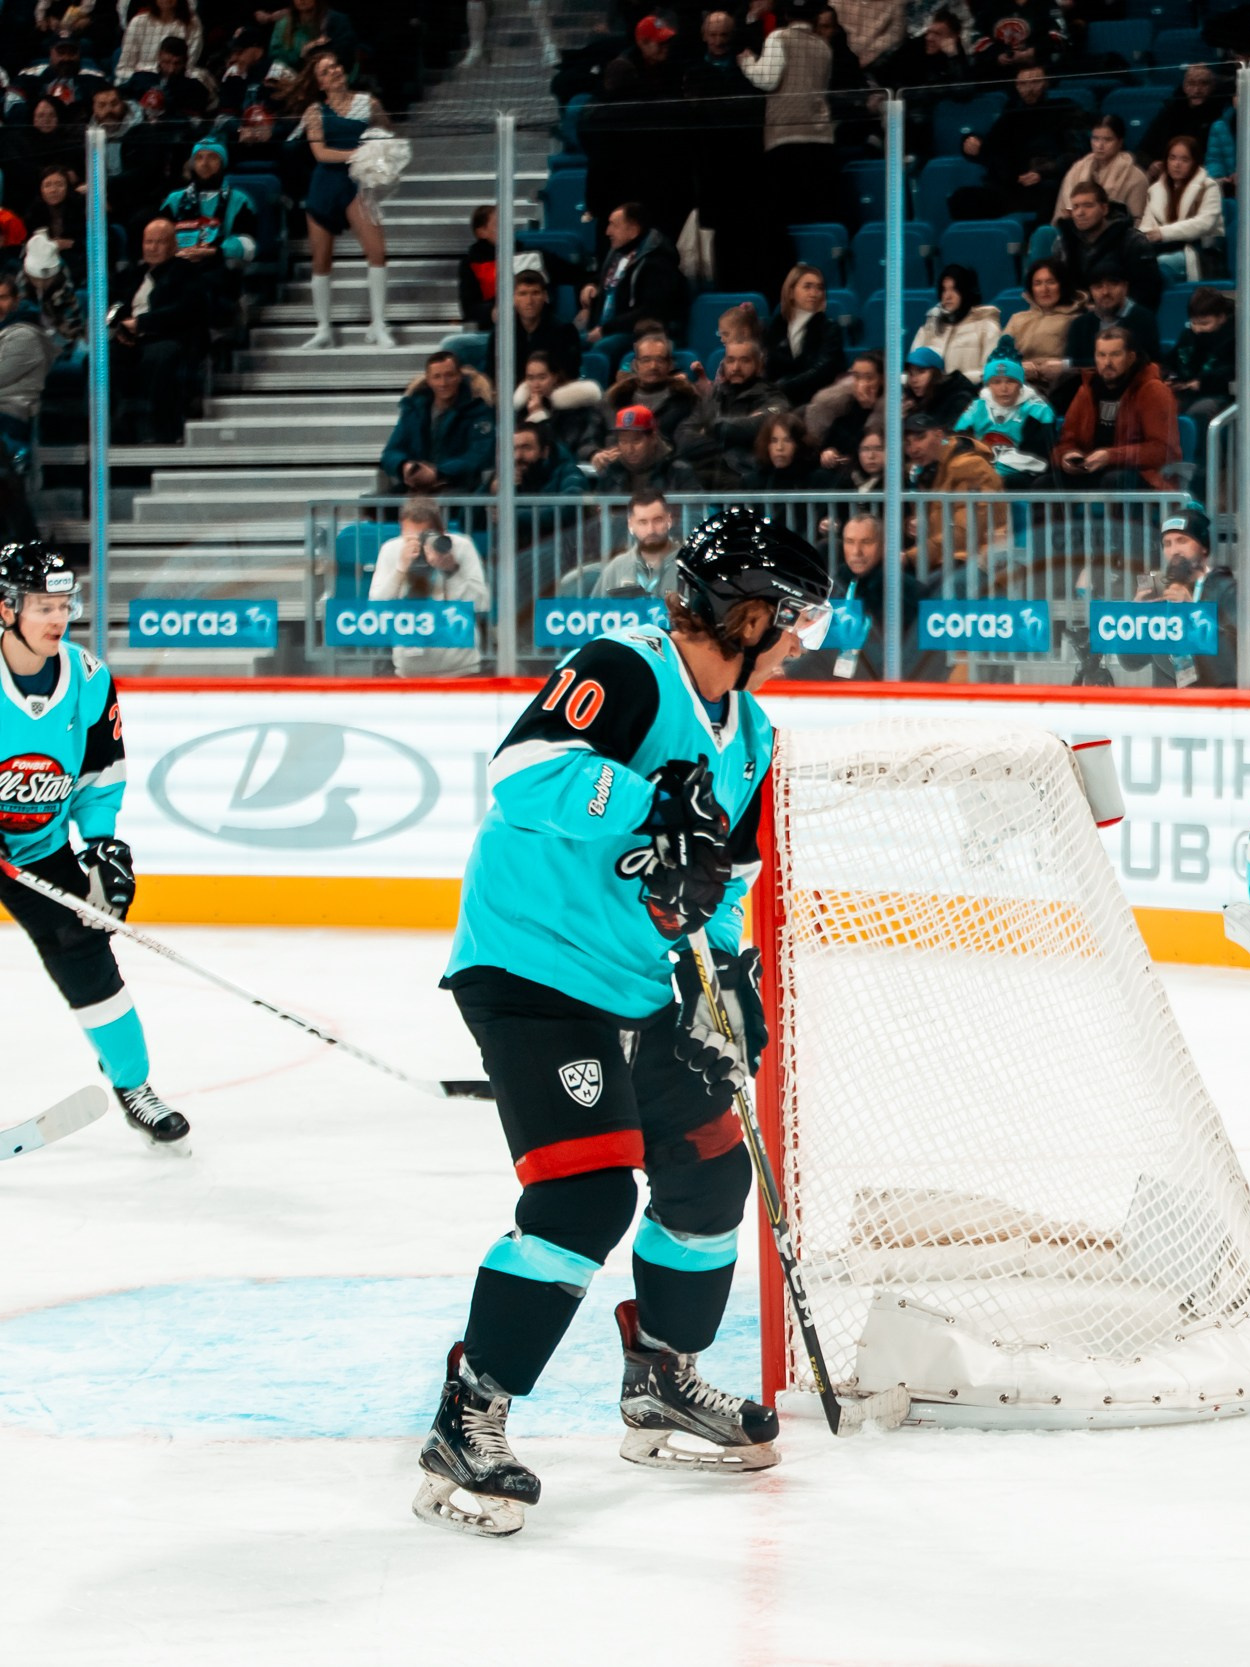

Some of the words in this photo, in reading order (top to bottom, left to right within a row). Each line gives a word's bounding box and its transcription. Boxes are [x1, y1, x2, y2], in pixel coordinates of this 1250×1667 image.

[771, 580, 803, 597] TRUE
[139, 611, 237, 636] согаз
[336, 610, 435, 636] согаз
[546, 611, 640, 636] согаз
[927, 613, 1014, 638] согаз
[1098, 614, 1183, 641] согаз
[543, 668, 605, 730] 10
[12, 759, 53, 771] FONBET
[0, 770, 74, 803] ll-Star
